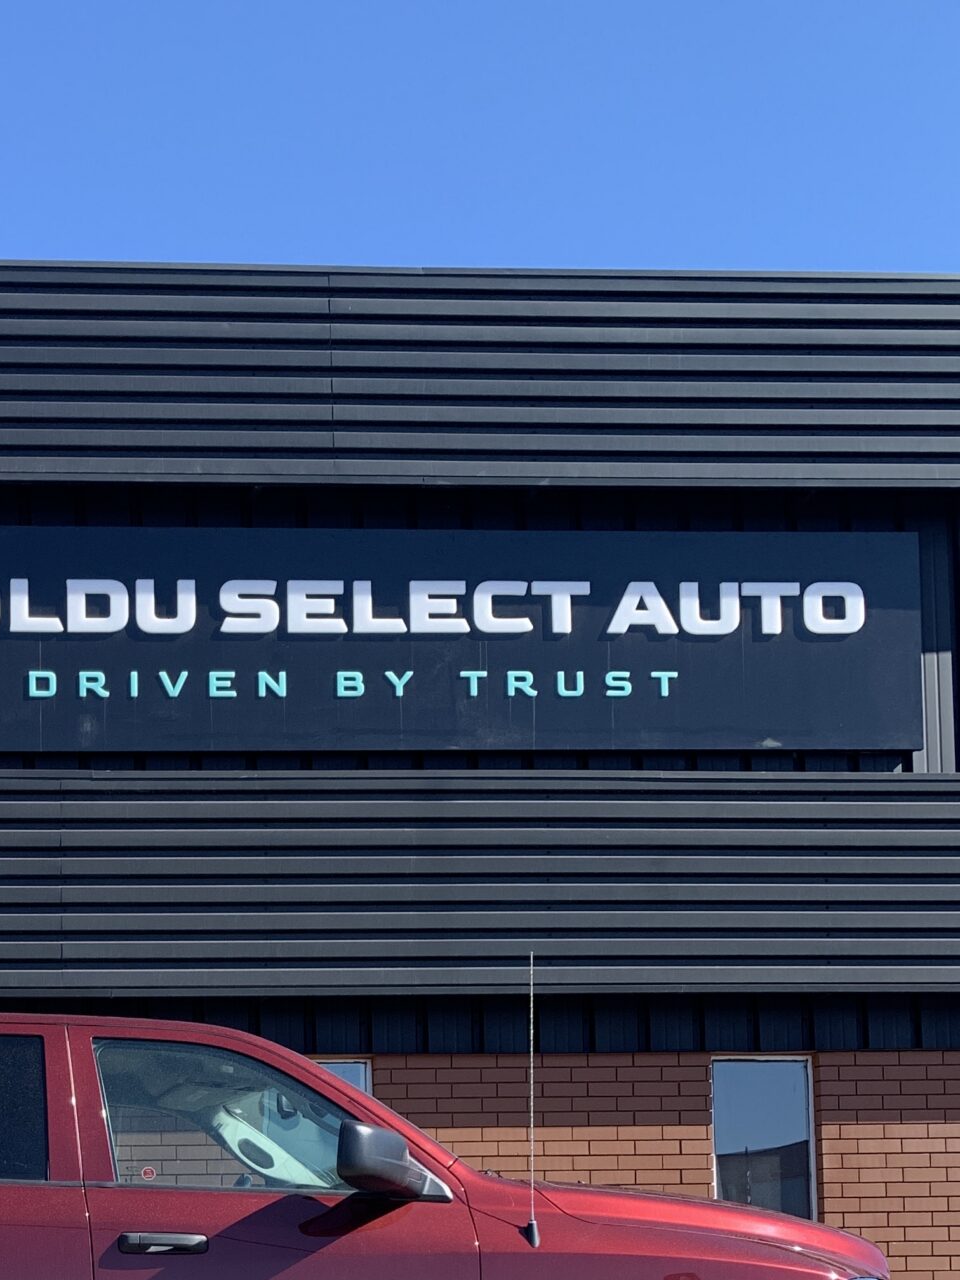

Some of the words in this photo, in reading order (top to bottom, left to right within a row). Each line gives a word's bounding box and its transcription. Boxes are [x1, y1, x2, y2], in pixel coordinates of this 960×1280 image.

[219, 579, 591, 635] SELECT
[606, 581, 866, 635] AUTO
[28, 670, 287, 698] DRIVEN
[336, 670, 414, 697] BY
[459, 670, 679, 697] TRUST
